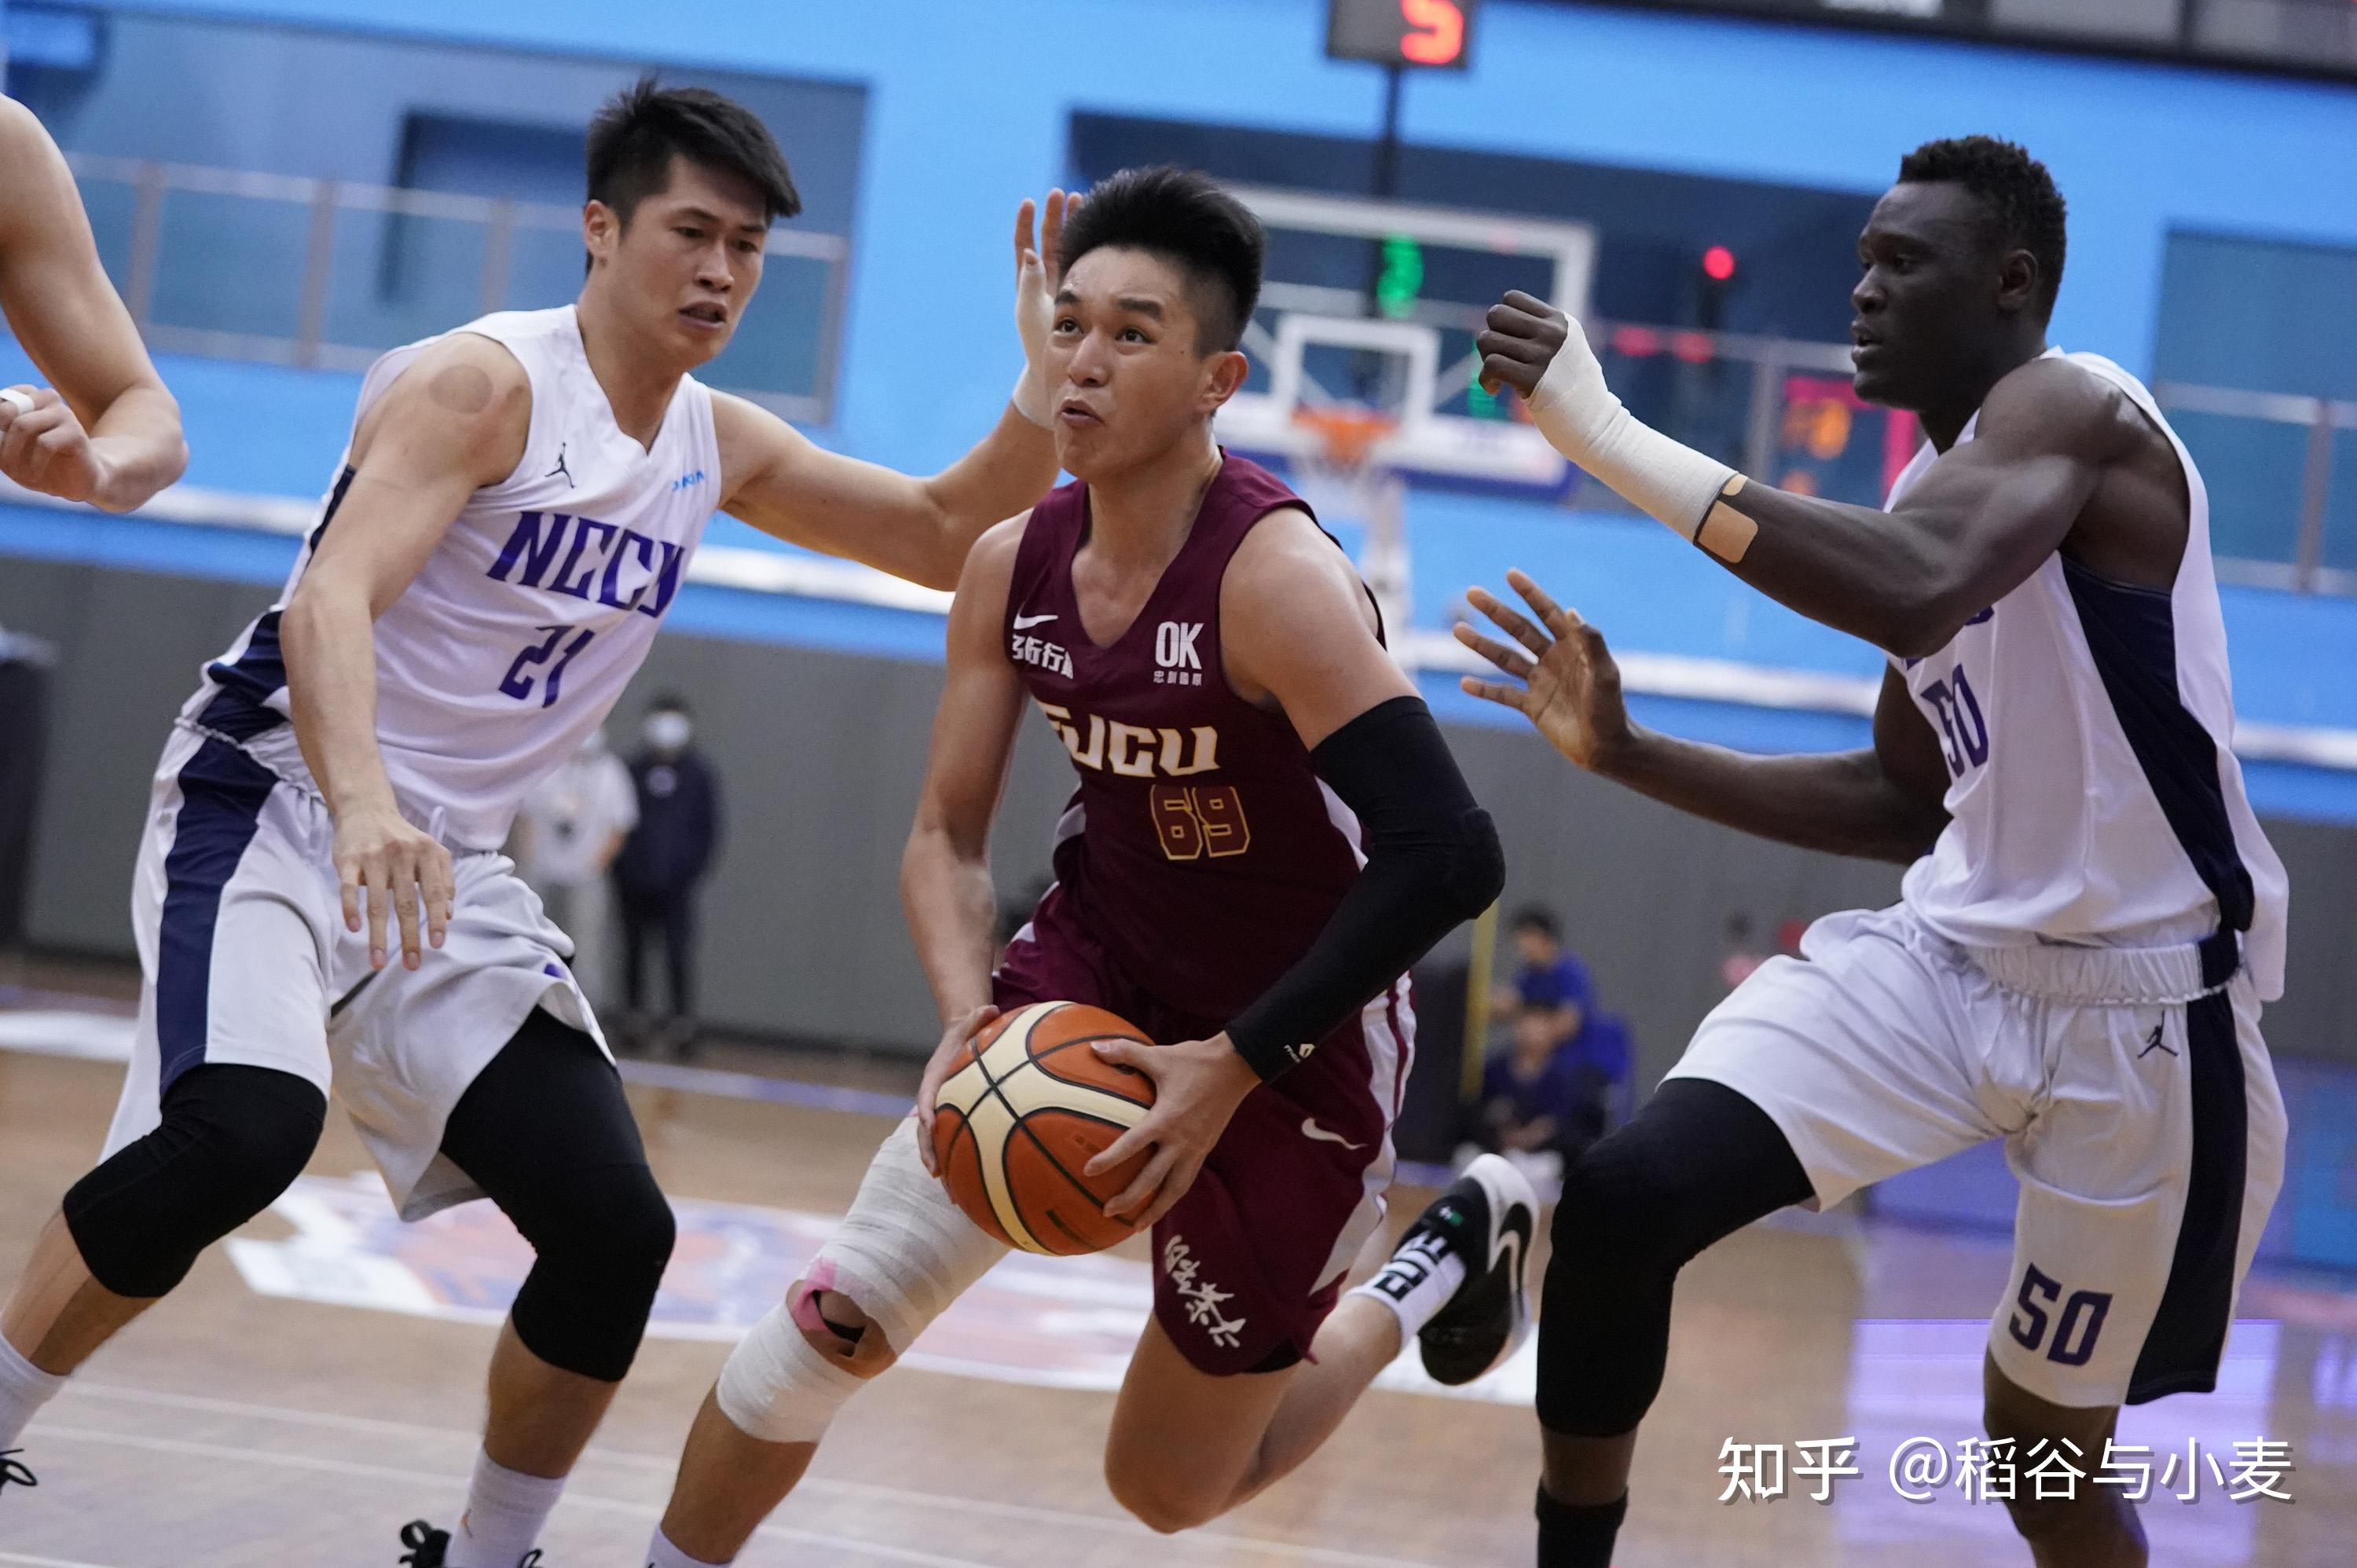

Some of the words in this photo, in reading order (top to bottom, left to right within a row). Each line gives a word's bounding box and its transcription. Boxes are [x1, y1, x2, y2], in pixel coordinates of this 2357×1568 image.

[498, 625, 596, 708] 21
[1155, 621, 1204, 669] OK
[1150, 784, 1250, 860] 69
[2009, 1262, 2113, 1366] 50
